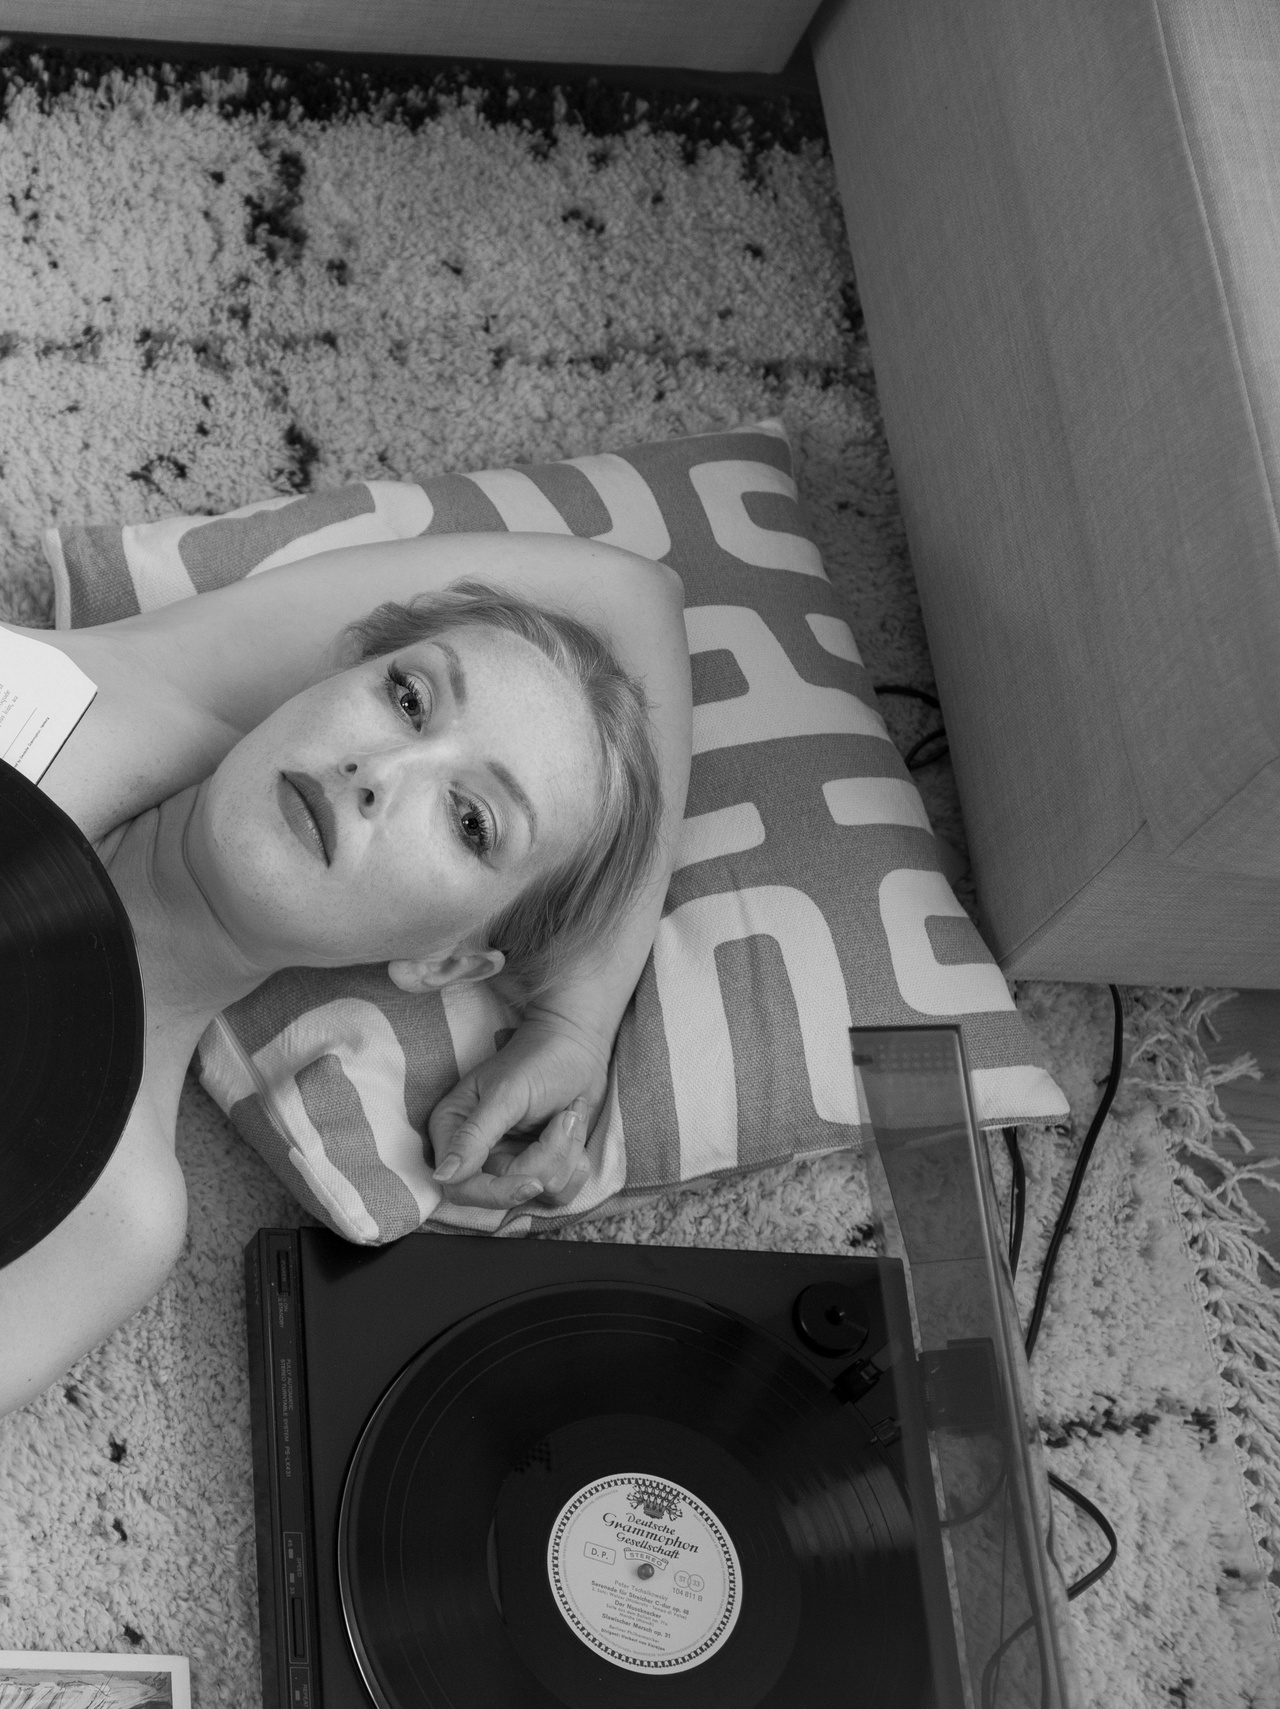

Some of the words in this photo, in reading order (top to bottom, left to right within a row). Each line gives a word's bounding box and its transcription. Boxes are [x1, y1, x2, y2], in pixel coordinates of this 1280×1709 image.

[282, 1301, 288, 1312] ON
[286, 1376, 294, 1410] AUTOMATIC
[279, 1358, 287, 1382] STEREO
[283, 1445, 291, 1477] PS-LX431
[601, 1512, 699, 1553] Grammophon
[624, 1512, 676, 1535] Deutsche
[287, 1538, 293, 1547] 45
[615, 1531, 682, 1559] Gesellschaft
[626, 1551, 665, 1567] STEREO
[288, 1586, 295, 1595] 33
[590, 1579, 618, 1593] Serenade
[618, 1588, 627, 1596] für
[628, 1591, 653, 1604] Streicher
[653, 1599, 671, 1609] C-dur
[613, 1578, 630, 1589] Peter
[630, 1584, 669, 1602] Tschaikowsky
[613, 1598, 625, 1607] Der
[625, 1602, 661, 1619] Nussknacker
[601, 1612, 631, 1626] Slawischer
[632, 1621, 652, 1633] Marsch
[652, 1629, 663, 1637] op.
[663, 1631, 671, 1639] 31
